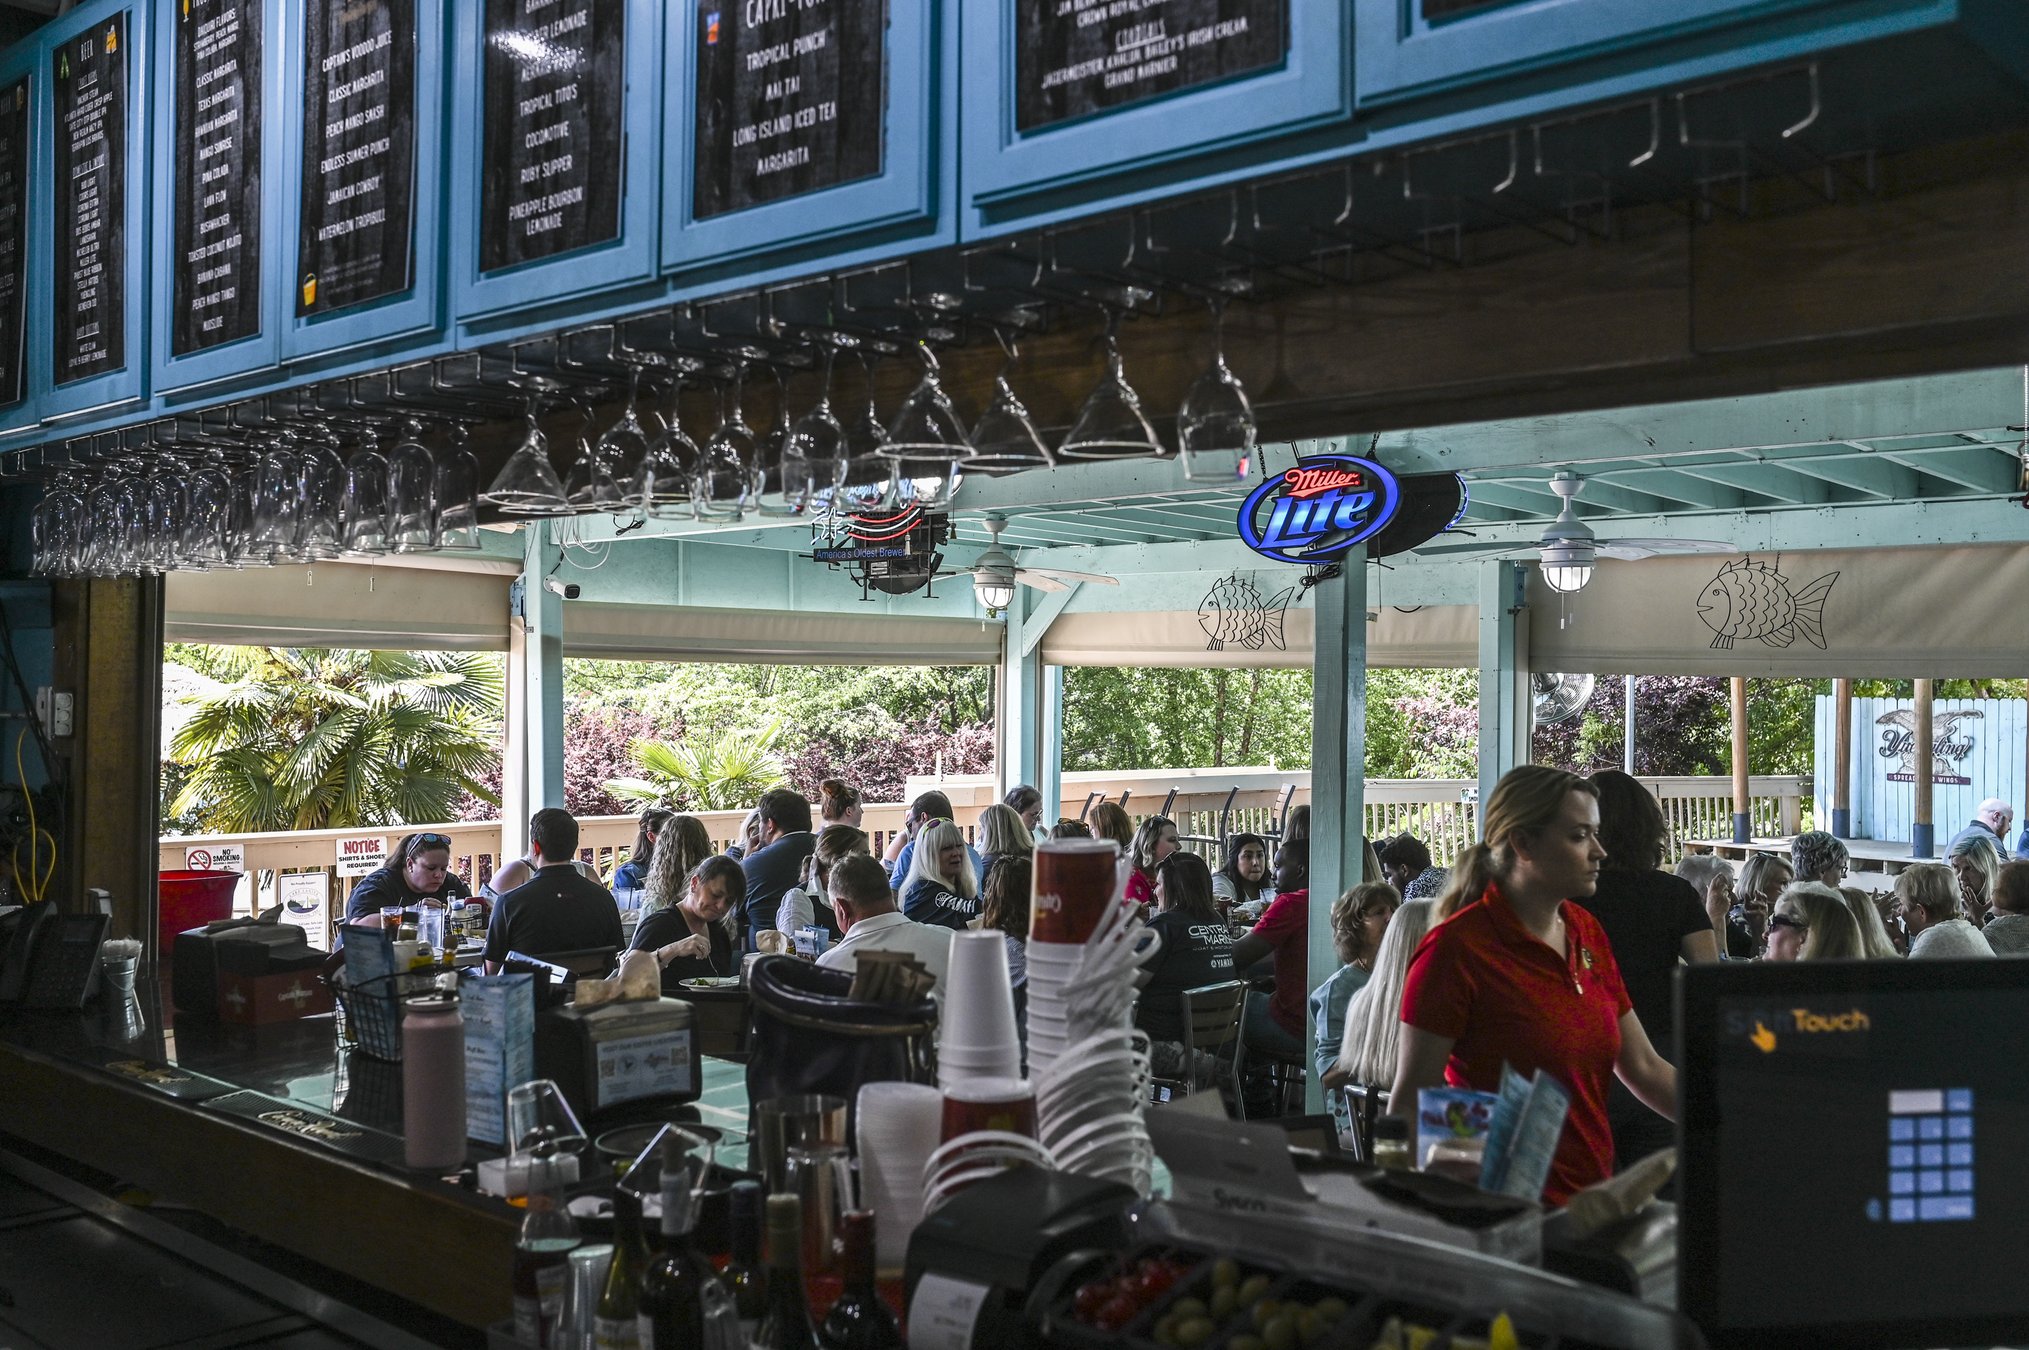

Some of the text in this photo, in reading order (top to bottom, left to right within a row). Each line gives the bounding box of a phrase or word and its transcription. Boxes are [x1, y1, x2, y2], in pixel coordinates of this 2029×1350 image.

[550, 9, 588, 39] LEMONADE
[1077, 5, 1108, 28] CROWN
[1115, 17, 1166, 50] CORDIALS
[1144, 33, 1186, 60] BAILEY'S
[1186, 26, 1214, 48] IRISH
[80, 39, 94, 62] BEER
[322, 30, 392, 72] CAPTAIN'S VOODOO JUICE
[746, 30, 826, 72] TROPICAL PUNCH
[196, 60, 238, 88] CLASSIC MARGARITA
[1104, 54, 1178, 90] GRAND MARNIER
[198, 86, 235, 112] TEXAS MARGARITA
[328, 69, 384, 104] CLASSIC MARGARITA
[520, 83, 578, 118] TROPICAL TITO'S
[765, 75, 800, 102] MAI TAI
[214, 108, 238, 130] MARGARITA
[326, 104, 384, 138] PEACH MANGO SMASH
[733, 101, 837, 148] LONG ISLAND ICED TEA
[199, 136, 233, 160] MANGO SUNRISE
[525, 120, 570, 149] COCOMOTIVE
[321, 137, 390, 174] ENDLESS SUMMER PUNCH
[520, 154, 573, 184] RUBY SLIPPER
[756, 145, 810, 176] MARGARITA
[212, 163, 229, 180] COLADA
[203, 189, 227, 208] LAVA FLOW
[328, 176, 380, 206] JAMAICAN COWBOY
[508, 186, 583, 221] PINEAPPLE BOURBON
[200, 212, 230, 234] BUSHWHACKER
[318, 218, 354, 242] WATERMELON
[526, 212, 562, 236] LEMONADE
[188, 233, 242, 263] TOASTED COCONUT MOJITO
[197, 262, 231, 284] BANANA CABANA
[192, 286, 235, 310] PEACH MANGO TANGO
[202, 316, 223, 332] MUDSLIDE
[1284, 468, 1361, 497] Miller
[1256, 486, 1376, 549] Lite
[816, 549, 852, 560] America's
[854, 548, 878, 558] Oldest
[344, 839, 380, 854] NOTICE
[941, 894, 976, 914] YAMAH
[1188, 924, 1230, 936] CENTRA
